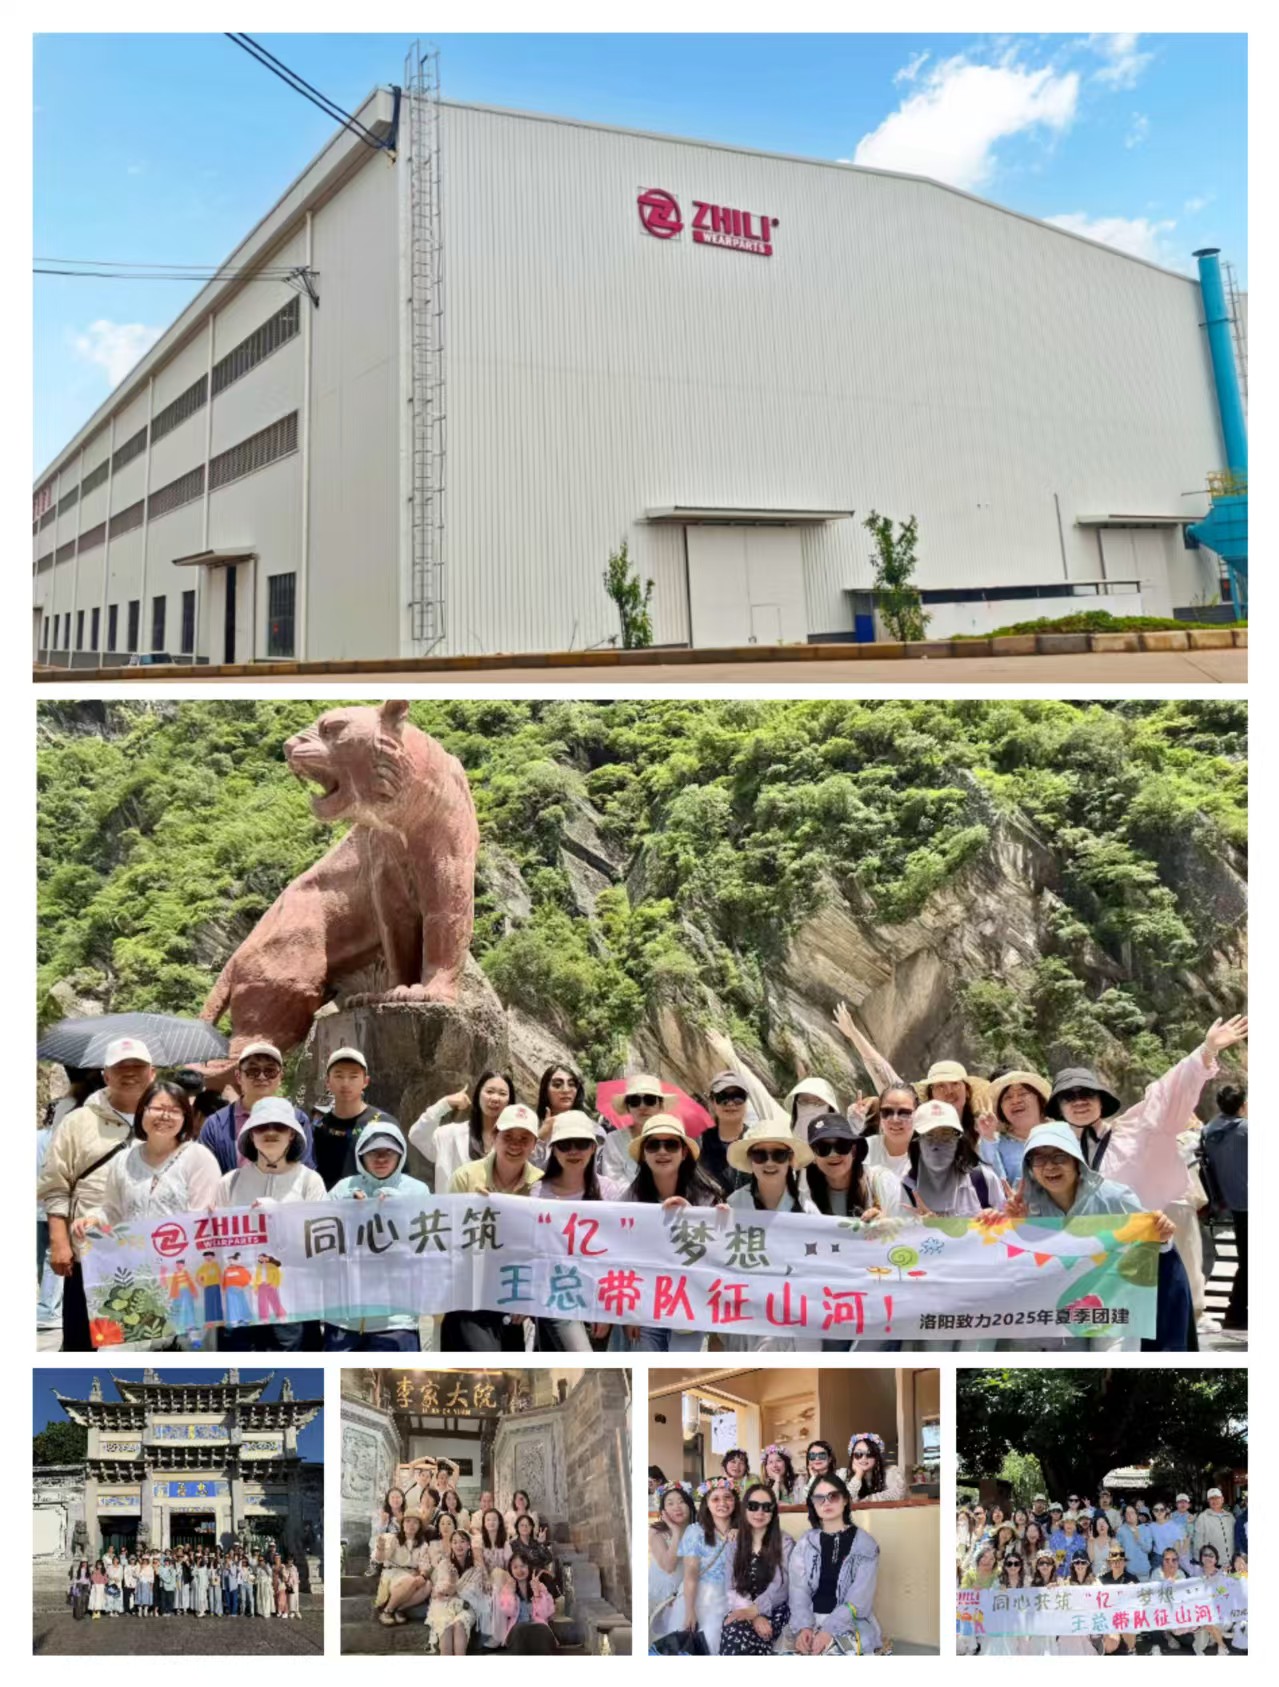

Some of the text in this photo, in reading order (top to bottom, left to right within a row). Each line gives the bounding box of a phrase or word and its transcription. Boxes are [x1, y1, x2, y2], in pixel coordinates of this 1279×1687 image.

[692, 200, 771, 242] ZHILI
[702, 231, 767, 253] WEARPARTS
[193, 1213, 267, 1240] ZHILI
[919, 1307, 1130, 1330] 洛阳致力2025年夏季团建
[396, 1376, 497, 1408] 李家大院
